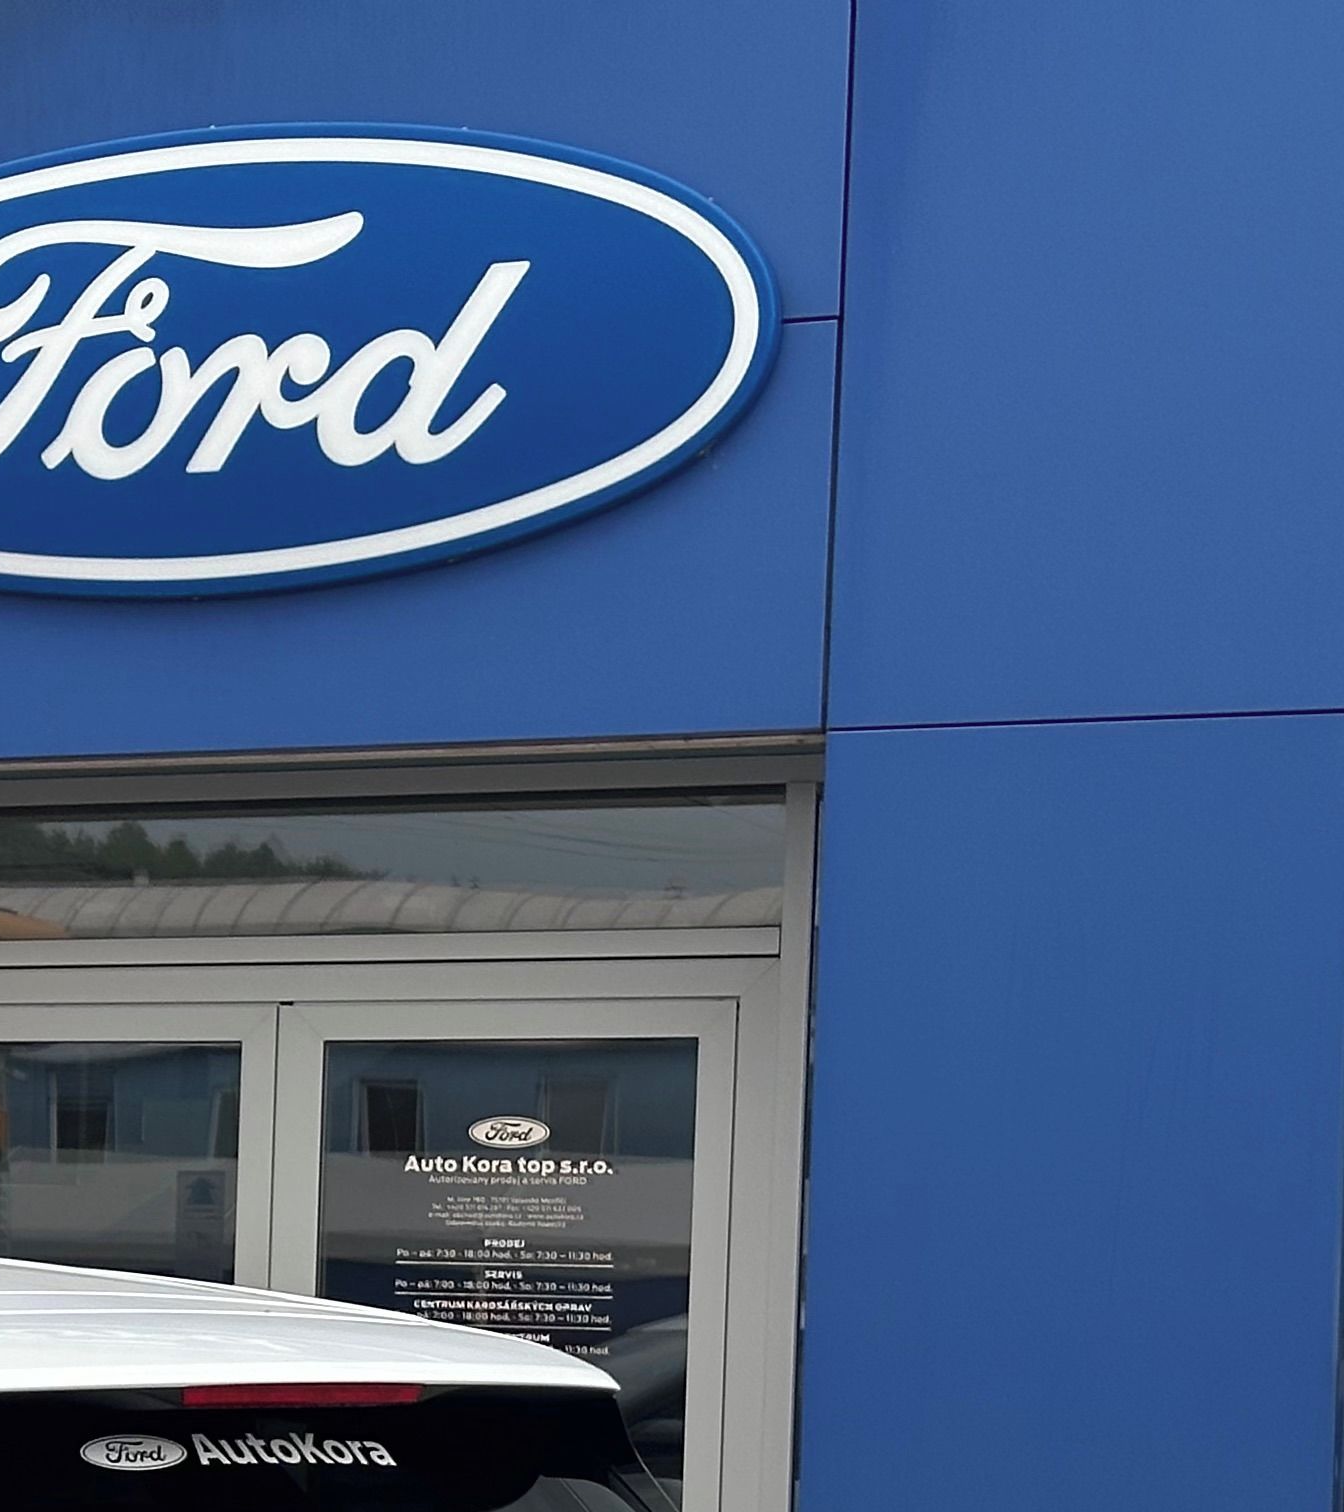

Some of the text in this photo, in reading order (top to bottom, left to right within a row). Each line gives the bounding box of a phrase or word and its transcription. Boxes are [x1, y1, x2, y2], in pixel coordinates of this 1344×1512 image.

[485, 1121, 534, 1142] Ford
[404, 1155, 614, 1176] Auto Kora top s.r.o.
[558, 1176, 587, 1186] FORD
[484, 1239, 525, 1248] PRODEJ
[104, 1440, 167, 1465] Ford
